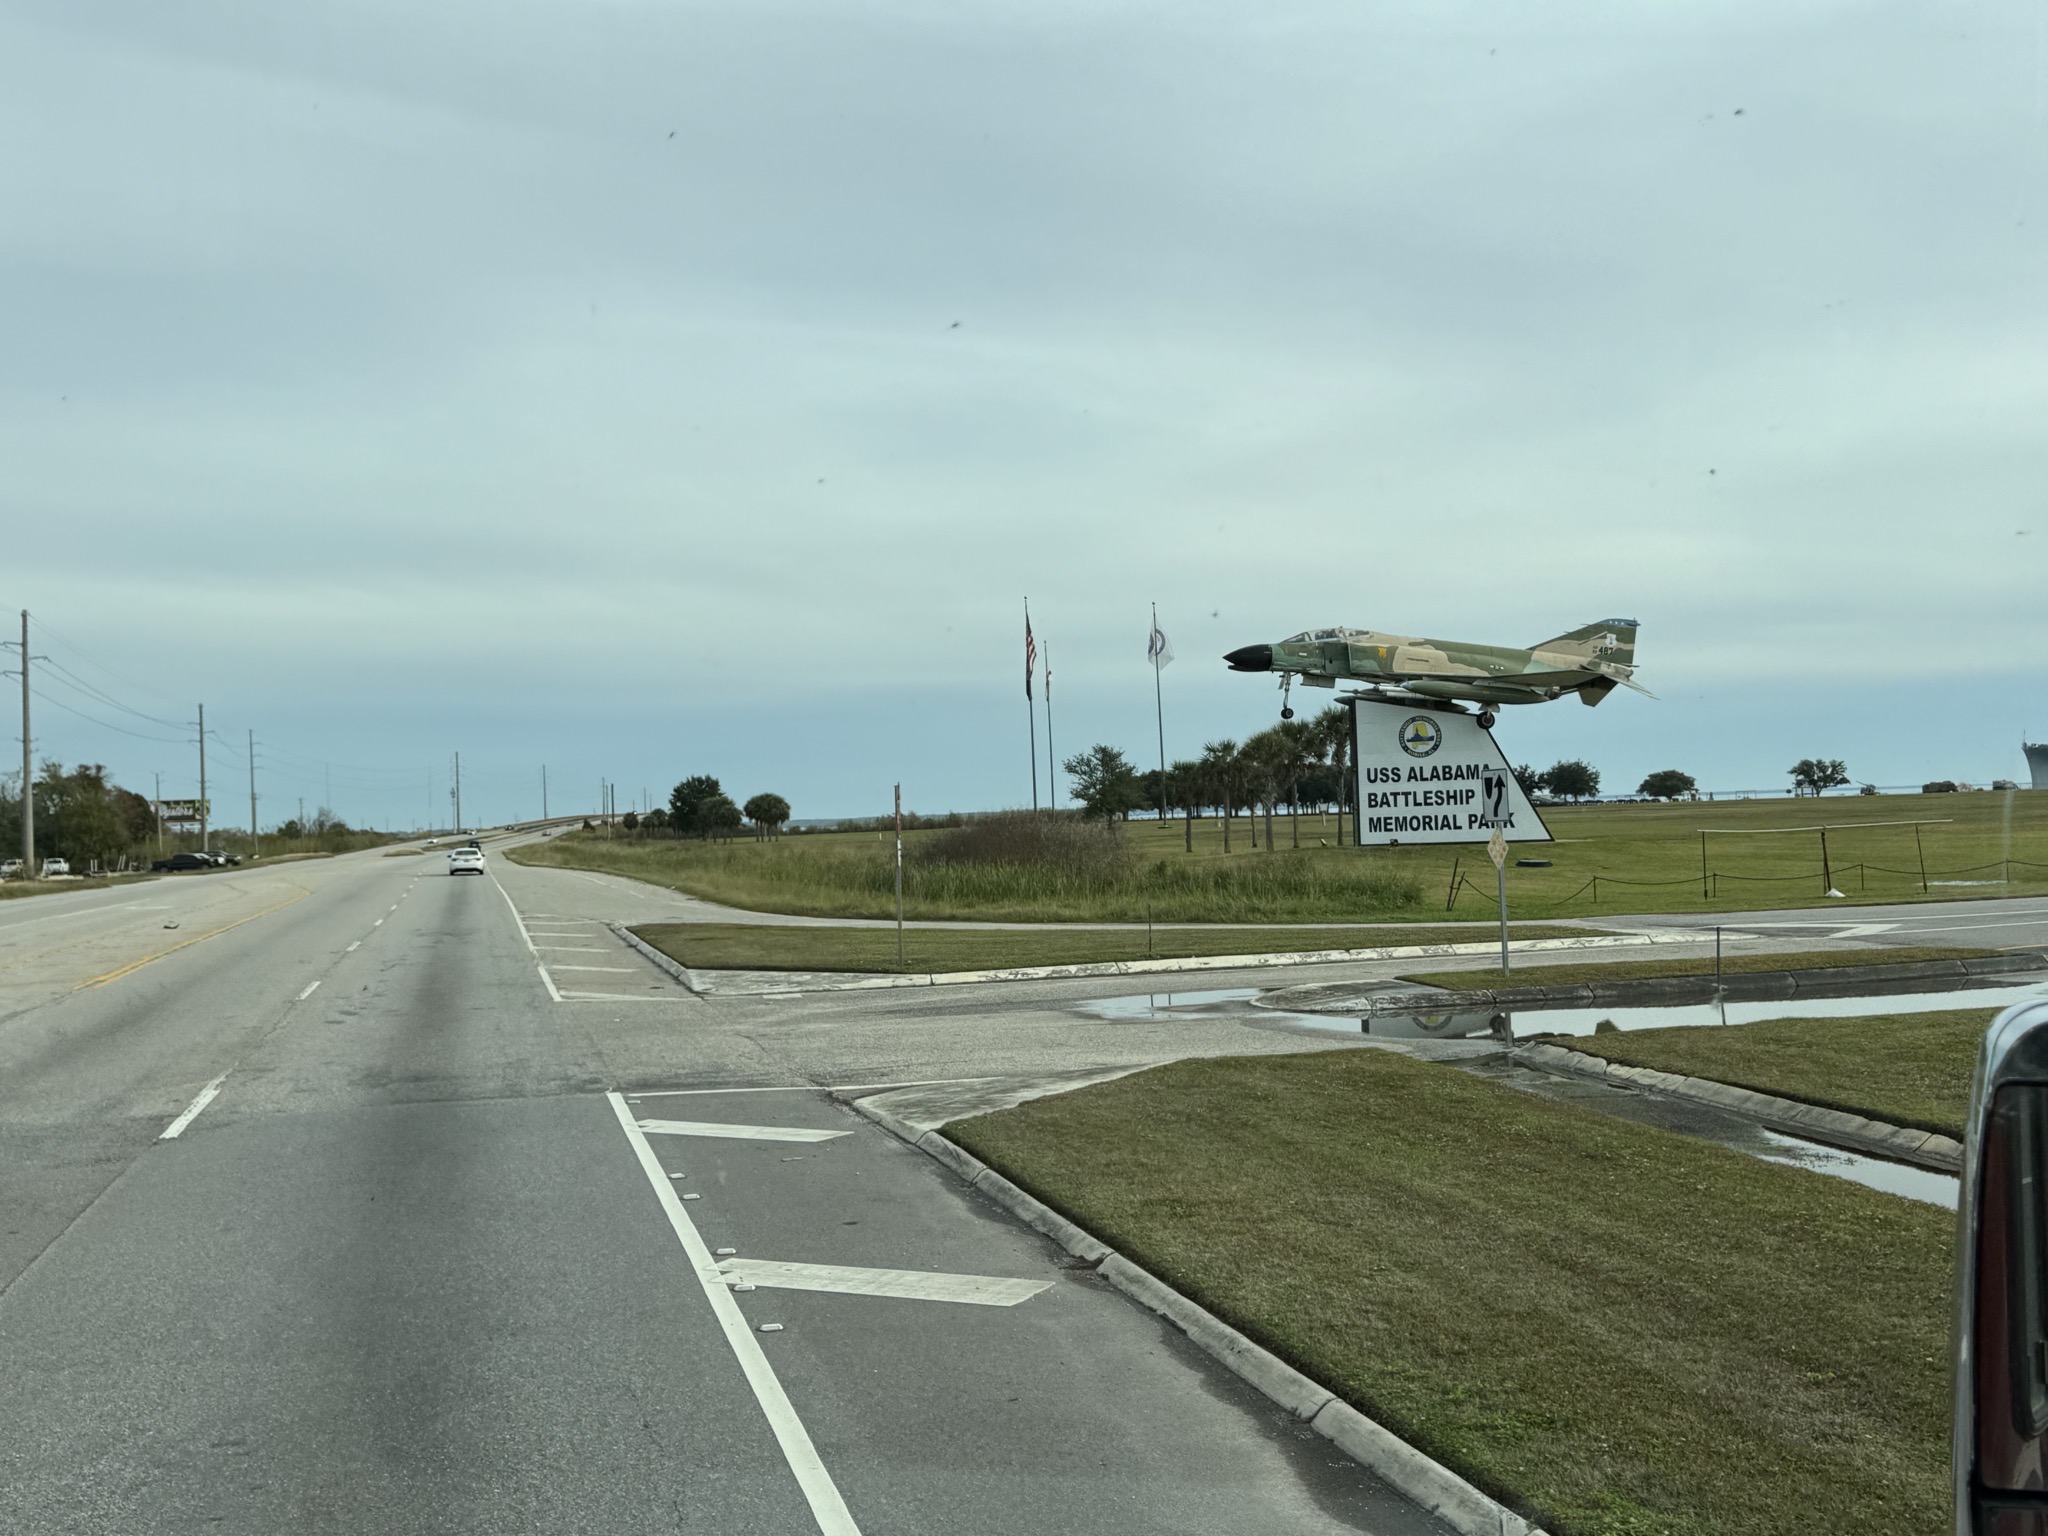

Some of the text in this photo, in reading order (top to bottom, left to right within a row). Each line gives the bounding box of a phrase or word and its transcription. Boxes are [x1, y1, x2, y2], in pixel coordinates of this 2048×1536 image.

[1598, 646, 1614, 655] 487
[1366, 768, 1401, 783] USS
[1368, 789, 1475, 808] BATTLESHIP
[1369, 814, 1462, 832] MEMORIAL
